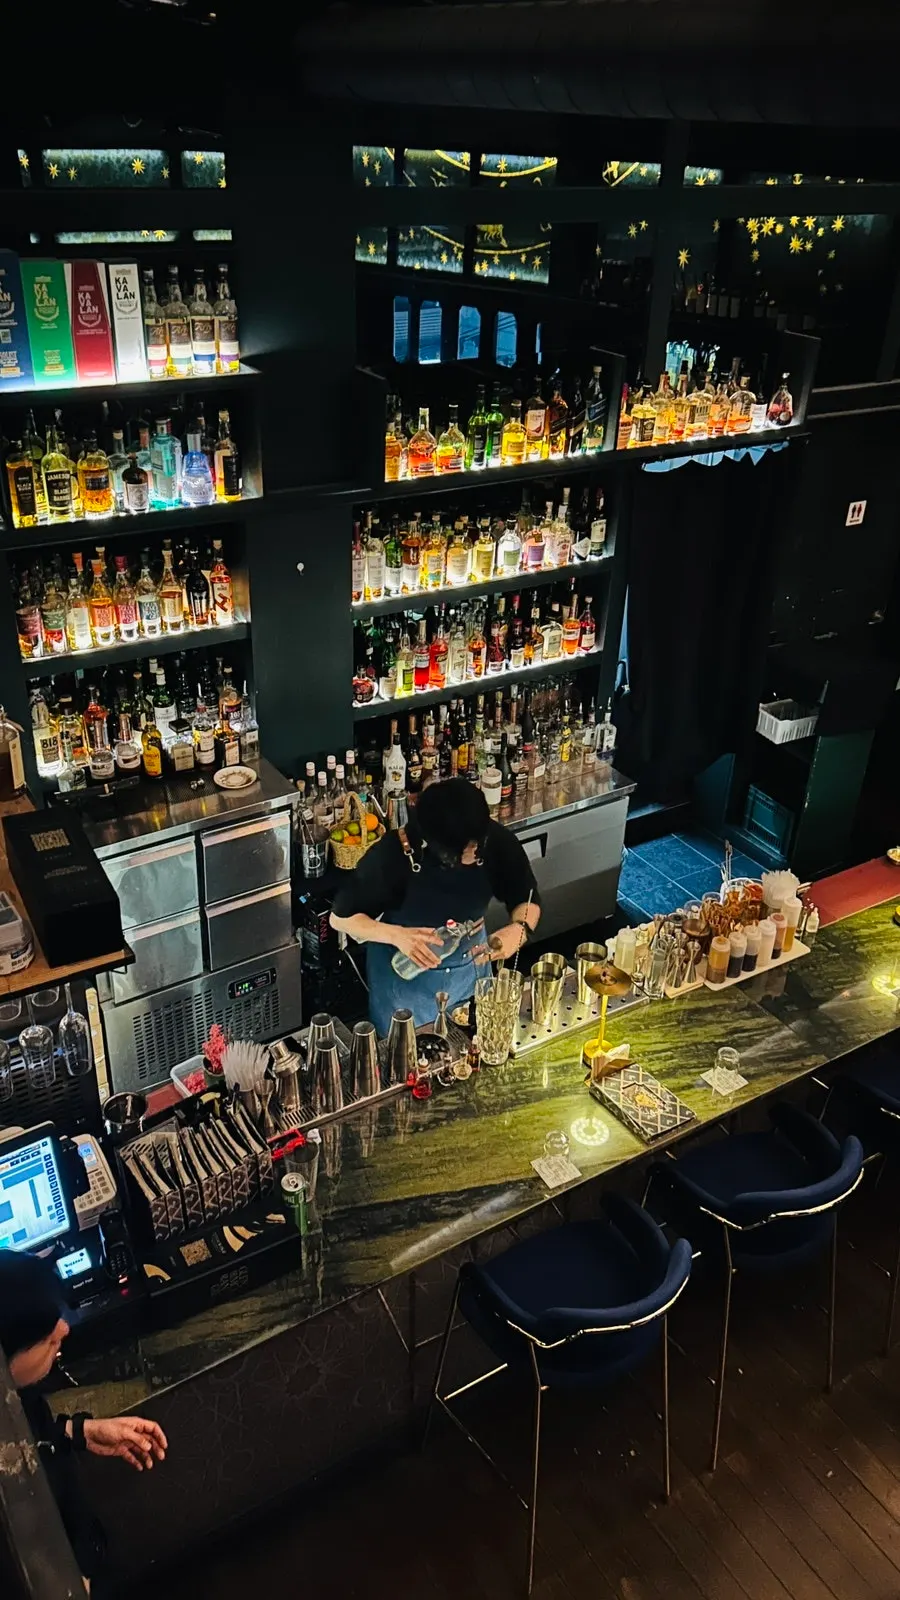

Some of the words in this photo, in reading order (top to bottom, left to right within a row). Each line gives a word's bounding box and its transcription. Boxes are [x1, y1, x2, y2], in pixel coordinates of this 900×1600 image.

[115, 276, 128, 285] KA
[34, 283, 48, 292] KA
[116, 284, 129, 292] VA
[0, 292, 11, 301] AN
[35, 290, 49, 299] VA
[78, 292, 91, 300] KA
[116, 291, 136, 300] LAN
[36, 297, 56, 307] LAN
[79, 299, 92, 307] VA
[80, 305, 99, 314] LAN
[42, 736, 58, 749] 818
